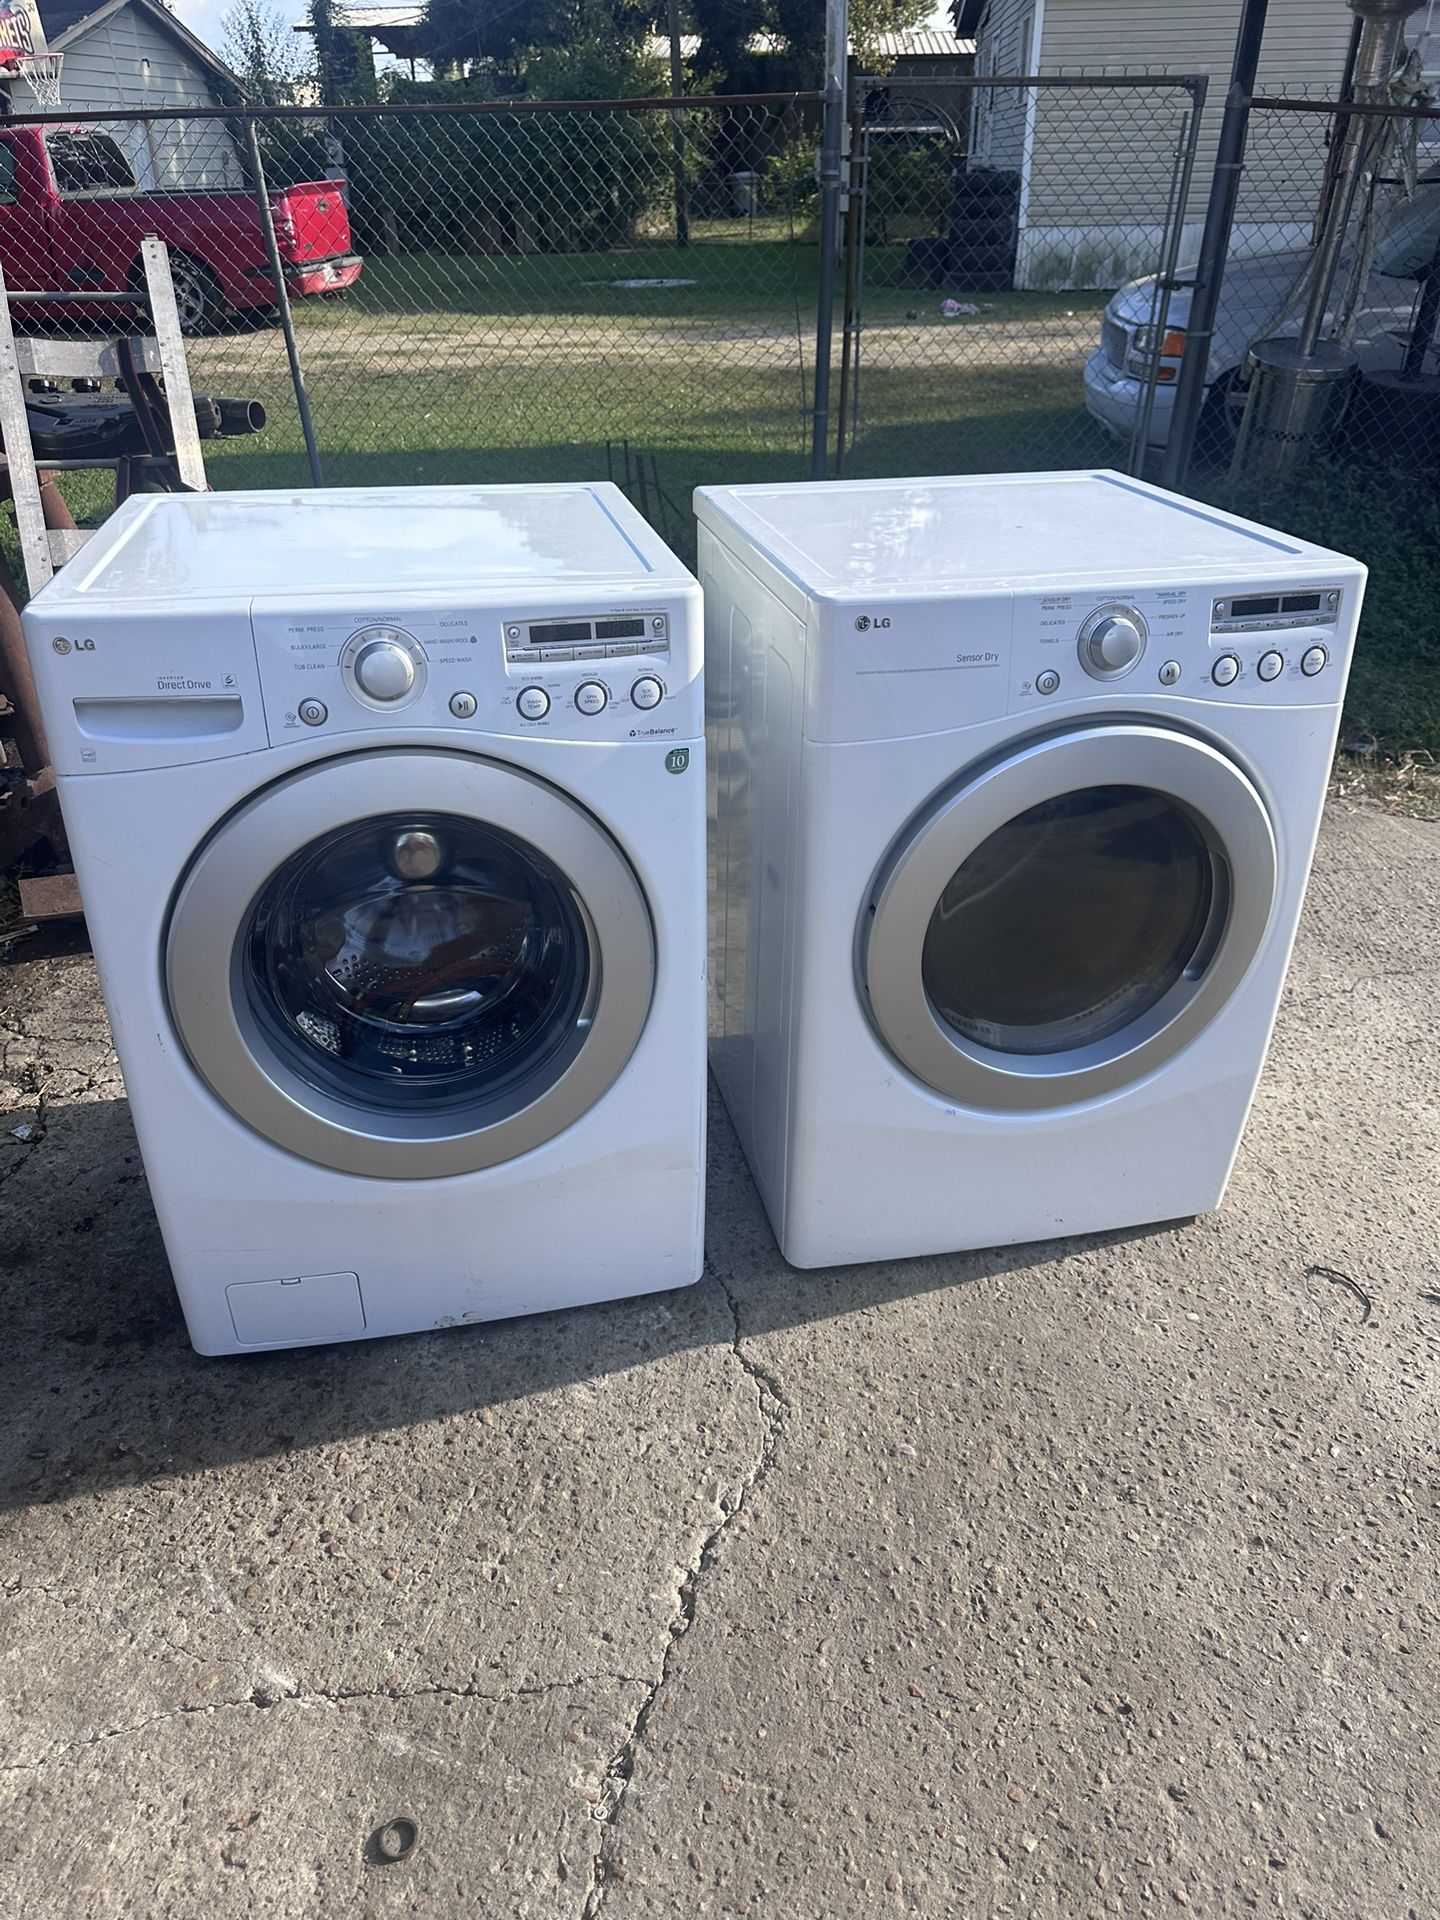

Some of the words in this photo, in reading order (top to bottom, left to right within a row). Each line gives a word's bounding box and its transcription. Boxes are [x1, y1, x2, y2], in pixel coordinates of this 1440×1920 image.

[873, 618, 891, 629] LG
[74, 639, 96, 651] LG
[956, 653, 983, 663] Sensor
[984, 652, 1000, 663] Dry
[157, 680, 186, 690] Direct
[186, 680, 212, 689] Drive
[671, 755, 685, 767] 10
